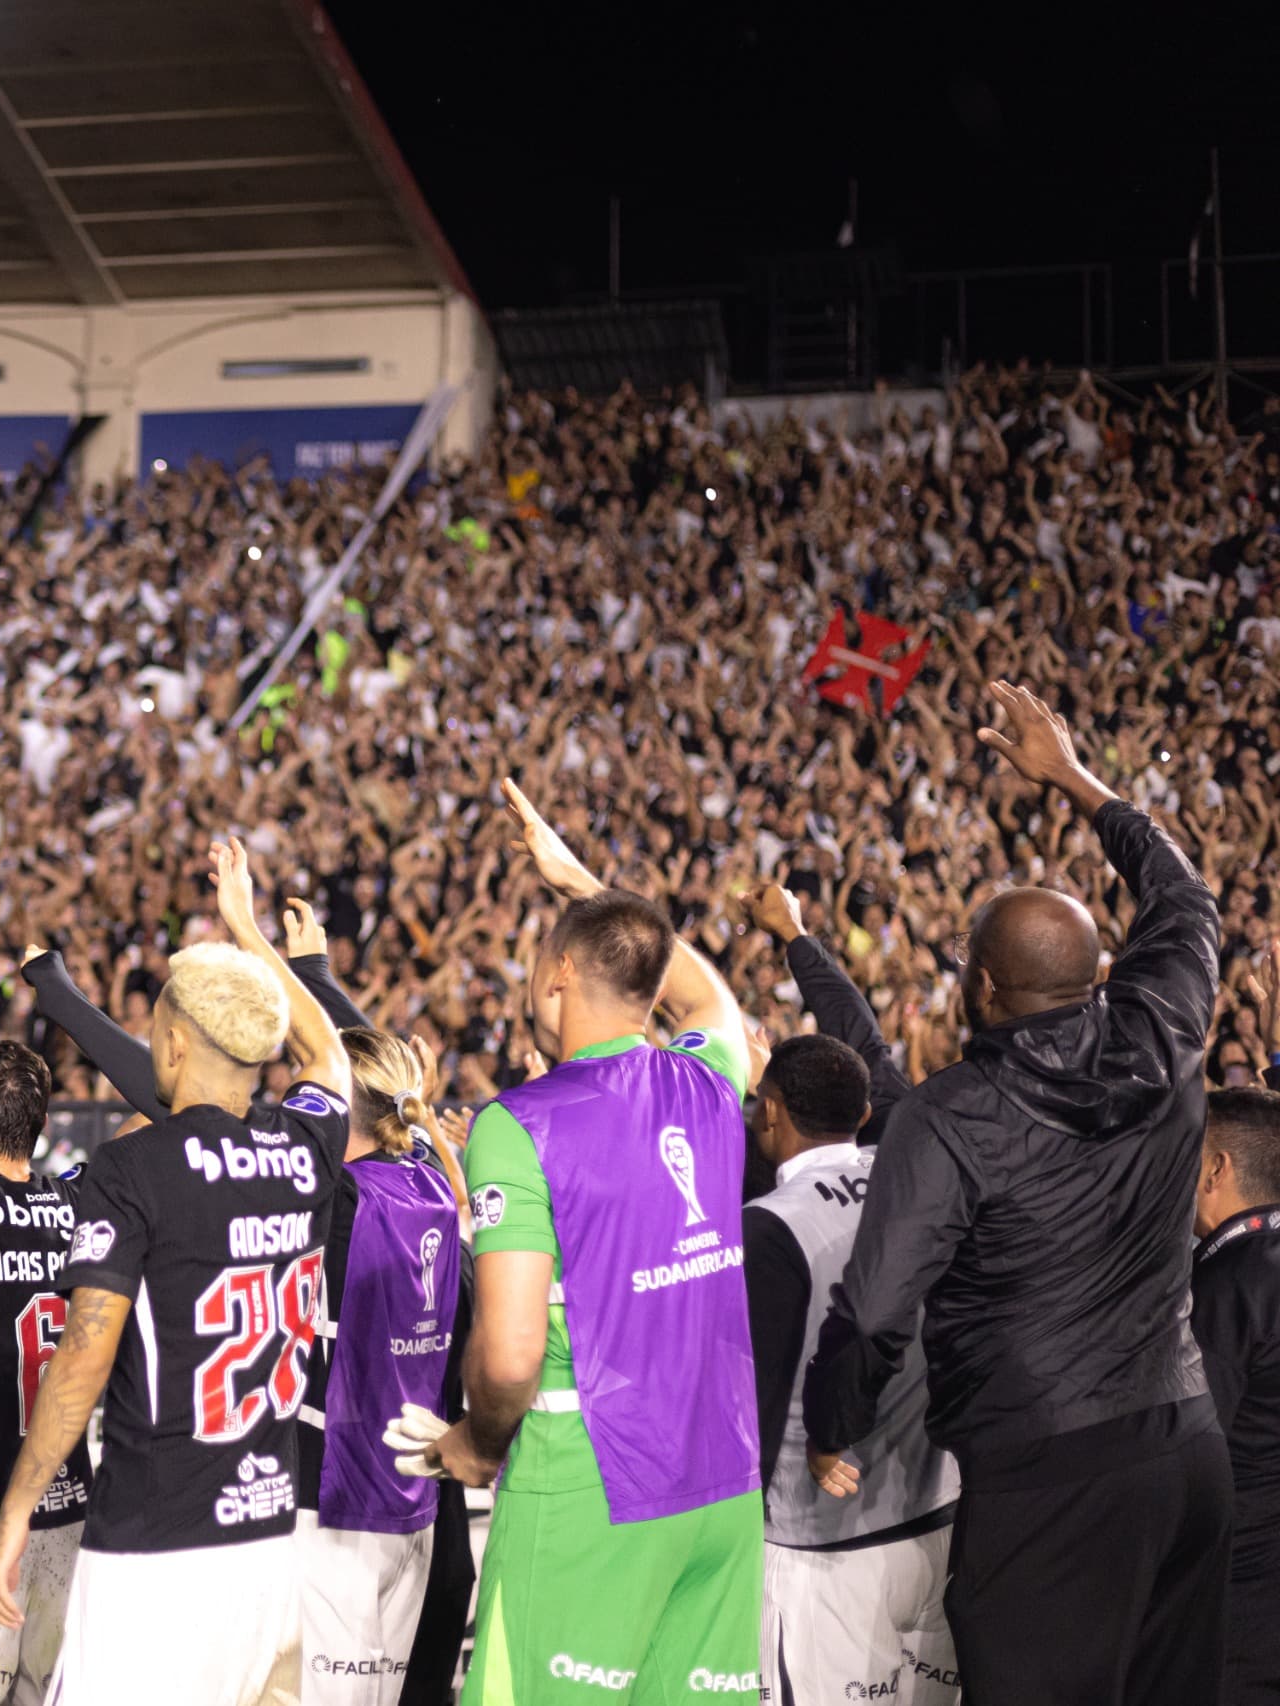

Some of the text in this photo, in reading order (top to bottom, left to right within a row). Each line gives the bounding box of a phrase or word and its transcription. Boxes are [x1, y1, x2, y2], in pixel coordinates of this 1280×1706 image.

[250, 1129, 290, 1144] banco
[221, 1137, 317, 1194] bmg
[5, 1195, 75, 1241] bmg
[229, 1211, 313, 1258] ADSON
[192, 1246, 325, 1442] 28
[35, 1483, 87, 1512] HEFE
[49, 1480, 71, 1491] OTO
[215, 1485, 295, 1524] CHEFE
[332, 1661, 382, 1675] FACIL
